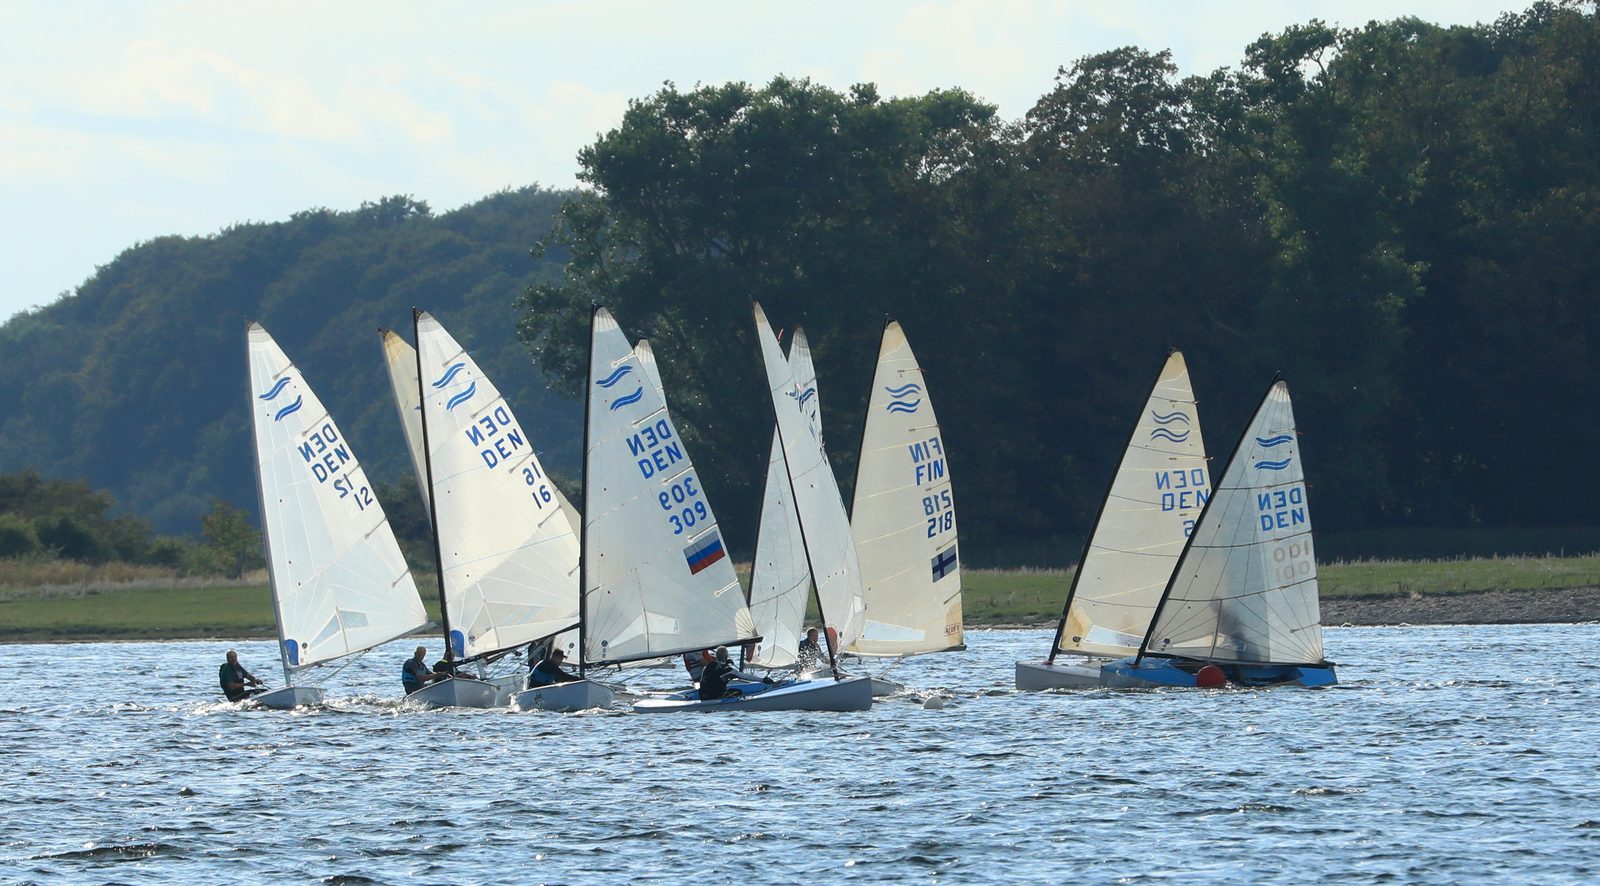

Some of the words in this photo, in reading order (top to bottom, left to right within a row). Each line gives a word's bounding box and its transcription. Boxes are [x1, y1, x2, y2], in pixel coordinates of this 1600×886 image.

[481, 428, 524, 469] DEN
[638, 441, 683, 479] DEN
[311, 444, 350, 483] DEN
[915, 458, 944, 486] FIN
[354, 486, 374, 511] 12
[532, 485, 552, 510] 16
[1161, 489, 1209, 512] DEN
[669, 501, 707, 535] 309
[927, 510, 953, 539] 218
[1260, 507, 1305, 532] DEN
